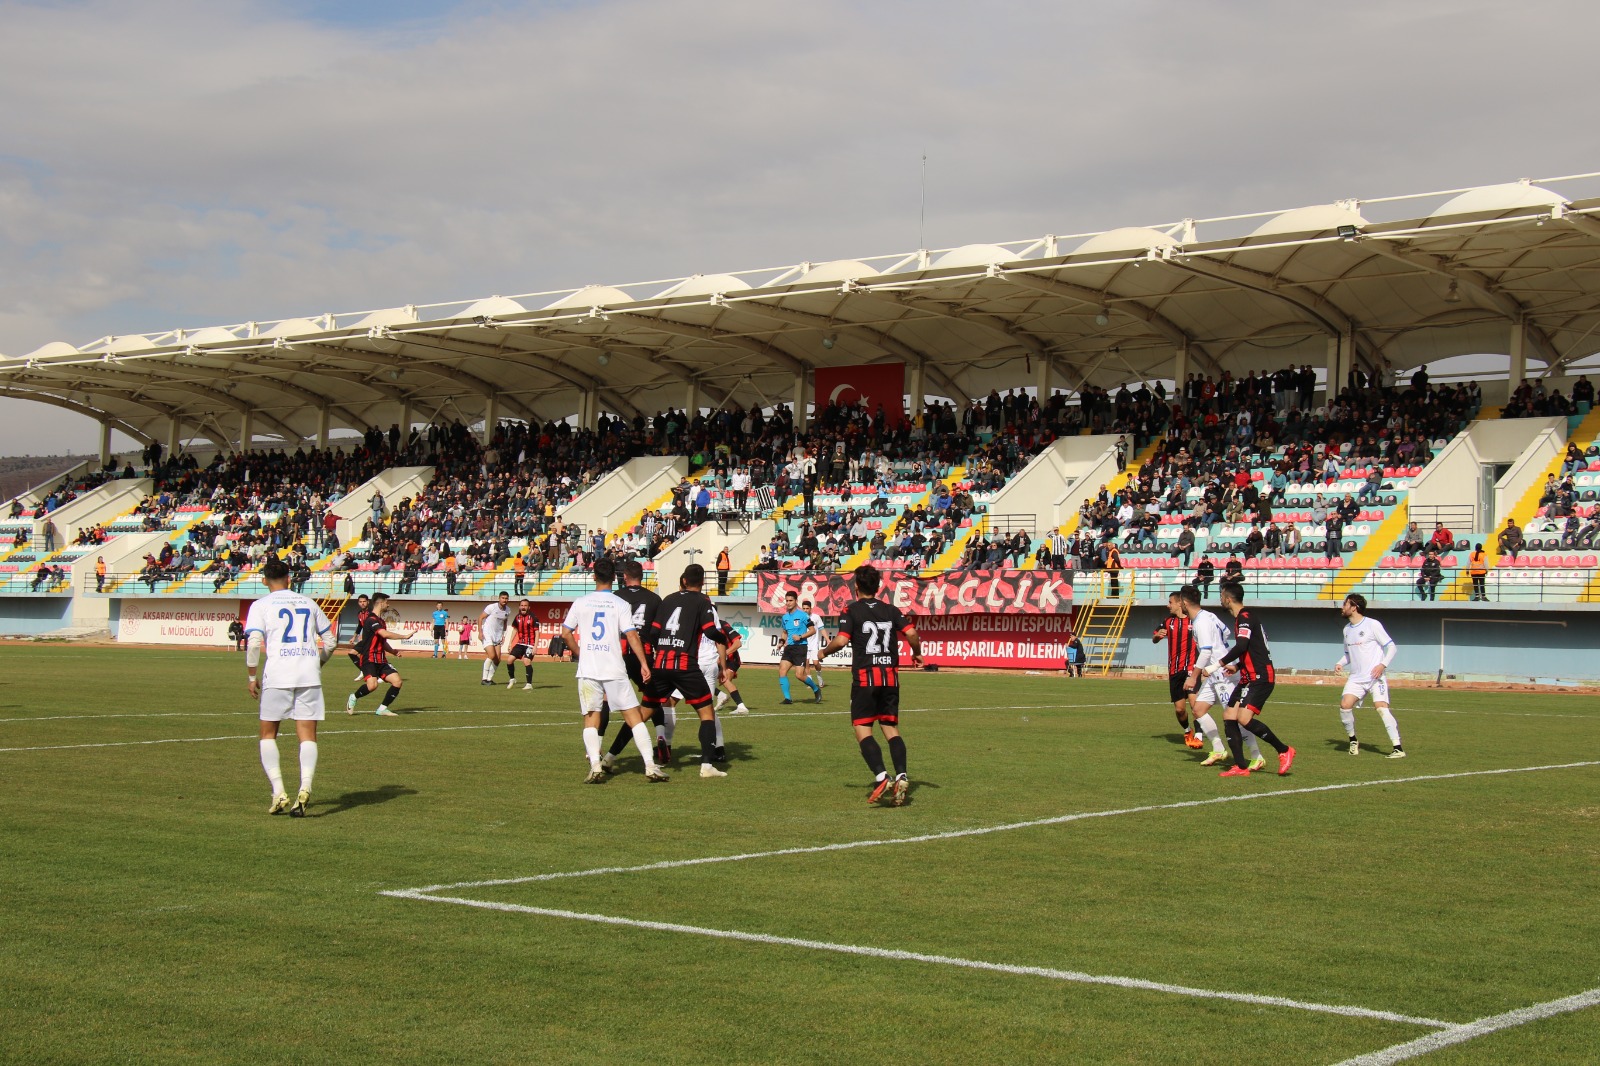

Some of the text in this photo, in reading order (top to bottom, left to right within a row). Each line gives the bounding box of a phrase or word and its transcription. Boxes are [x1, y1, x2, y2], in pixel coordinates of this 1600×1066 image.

[142, 610, 236, 624] AKSARAY GENÇLİK VE SPOR
[547, 608, 560, 620] 68
[665, 606, 682, 636] 4
[278, 608, 311, 643] 27
[591, 611, 606, 641] 5
[915, 615, 970, 631] AKSARAY
[160, 626, 215, 637] İL MÜDÜRLÜĞÜ
[861, 620, 893, 655] 27
[671, 636, 685, 648] İÇER
[898, 641, 907, 657] 2.
[946, 641, 1014, 661] BAŞARILAR
[1017, 638, 1068, 660] DİLERİM
[1220, 692, 1230, 702] 20
